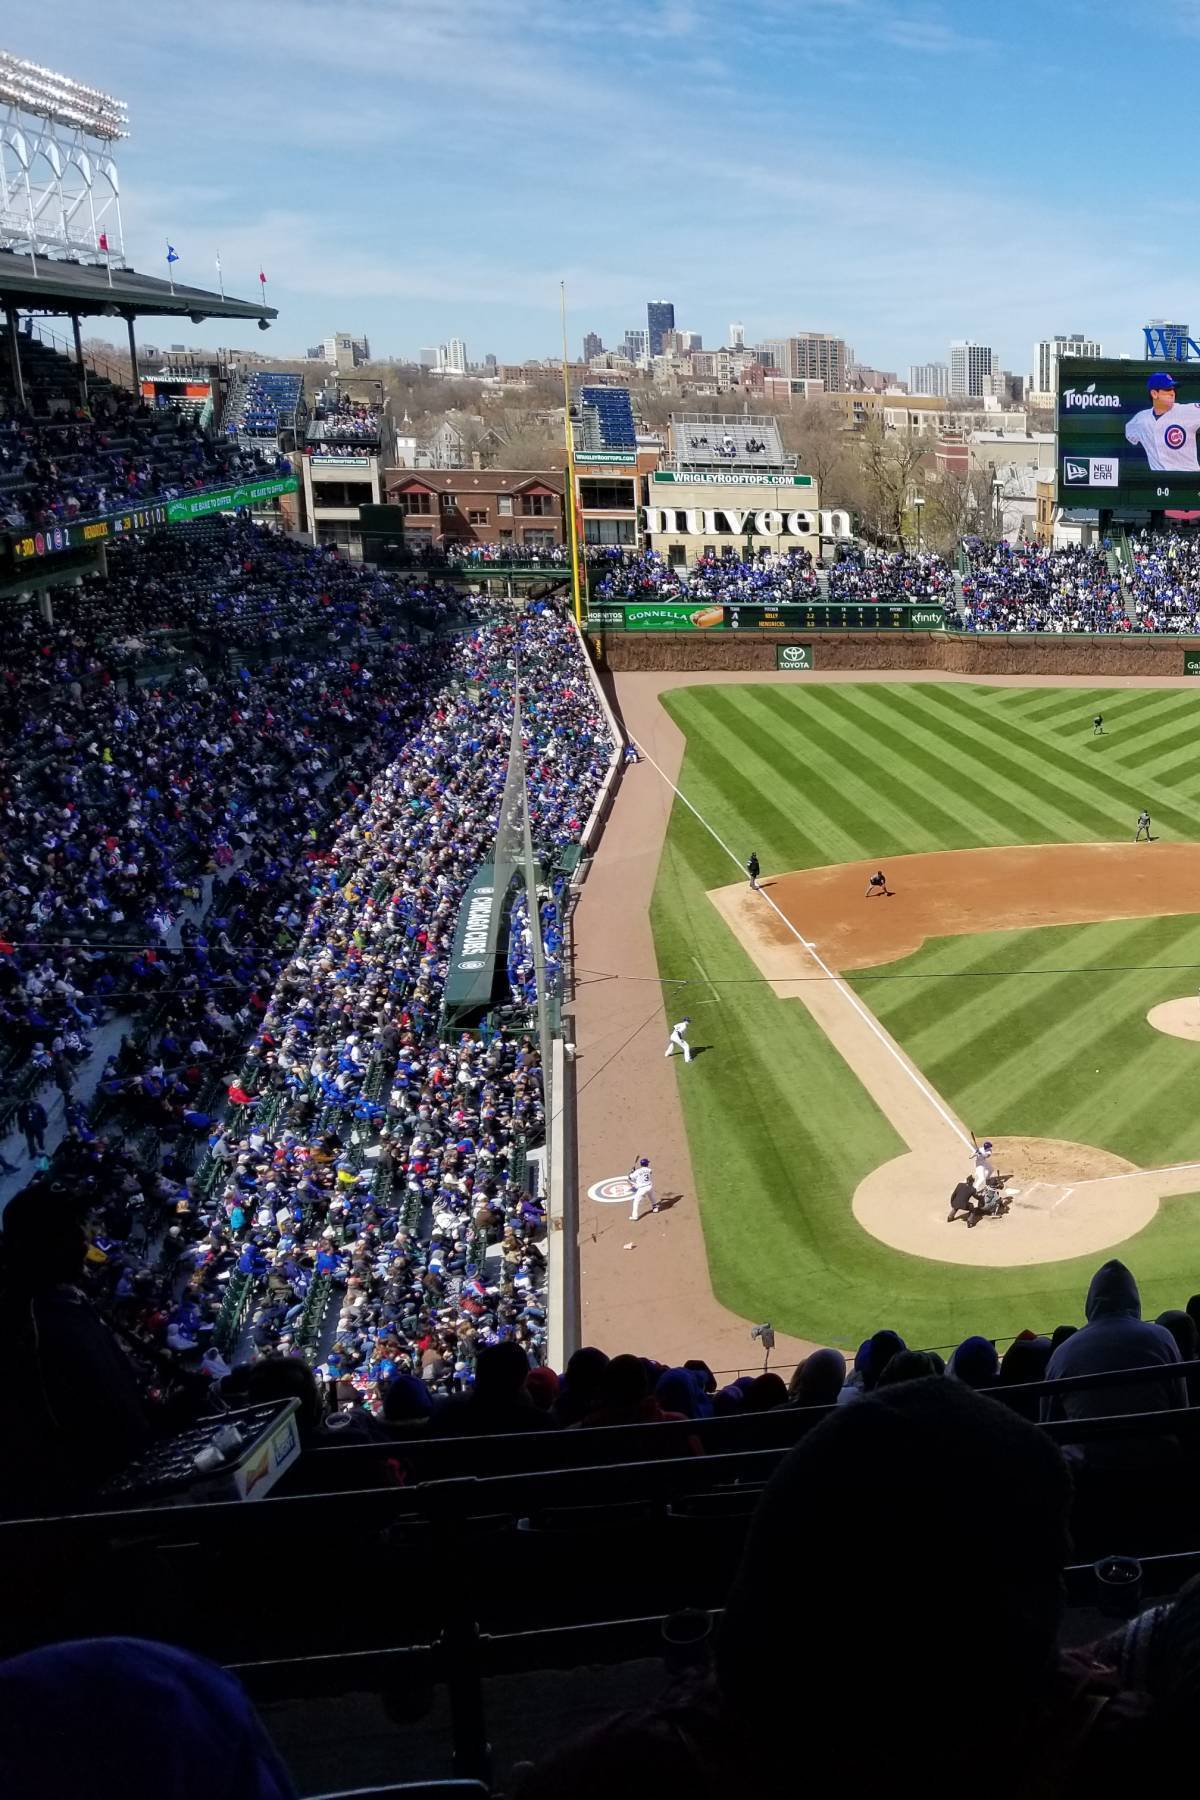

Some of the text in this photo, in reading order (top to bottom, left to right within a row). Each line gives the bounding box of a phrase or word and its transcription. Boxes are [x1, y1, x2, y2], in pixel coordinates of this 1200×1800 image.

[1062, 385, 1121, 409] Tropicana
[1093, 463, 1113, 472] NEW
[673, 473, 794, 485] WRIGLEYROOFTOPS.COM
[1093, 471, 1112, 480] ERA
[1156, 487, 1169, 497] 0-0
[642, 506, 853, 538] nuveen
[629, 610, 688, 621] GONNELLA
[912, 612, 943, 624] xfinity
[461, 896, 493, 955] CHICAGO CUBS
